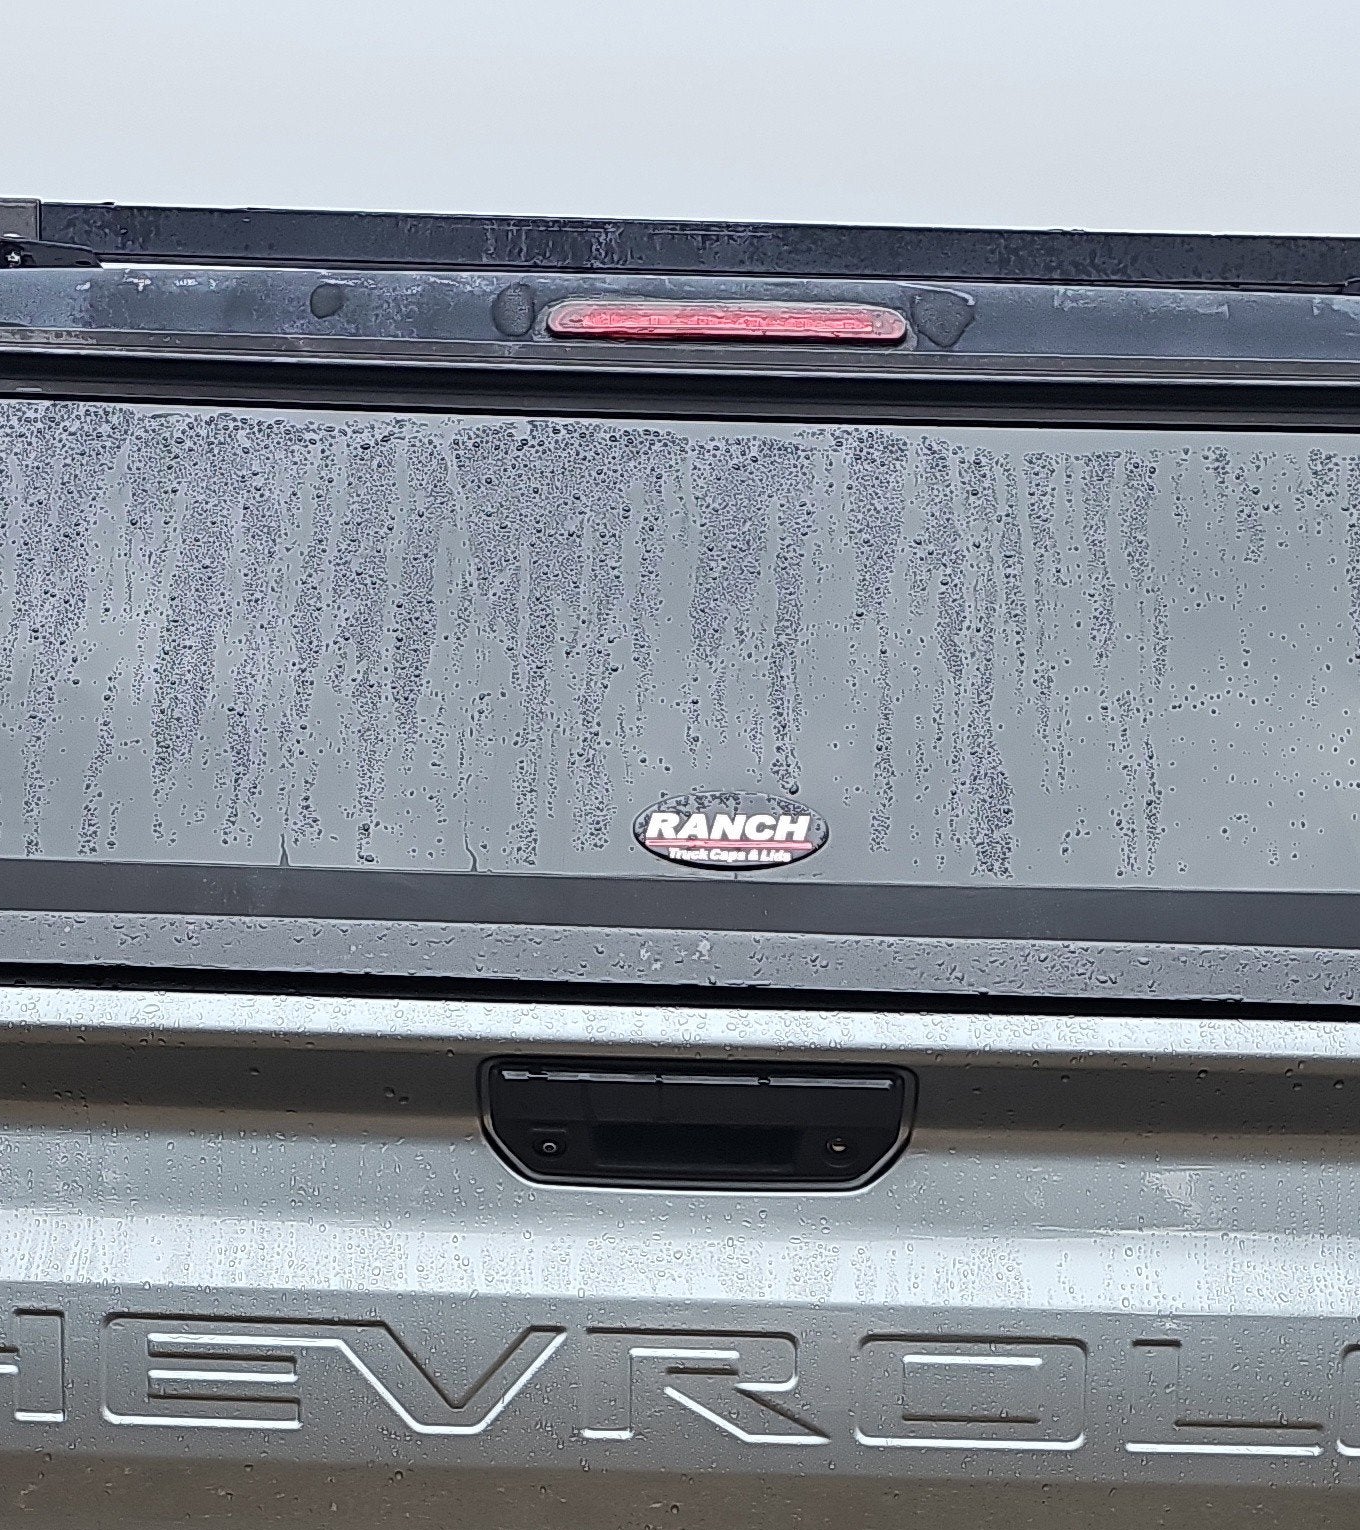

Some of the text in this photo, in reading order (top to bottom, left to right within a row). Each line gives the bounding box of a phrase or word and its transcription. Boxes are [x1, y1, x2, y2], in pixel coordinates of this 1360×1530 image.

[646, 812, 811, 841] RANCH
[668, 847, 708, 861] Truck
[710, 848, 746, 862] Caps
[760, 849, 792, 862] Lids
